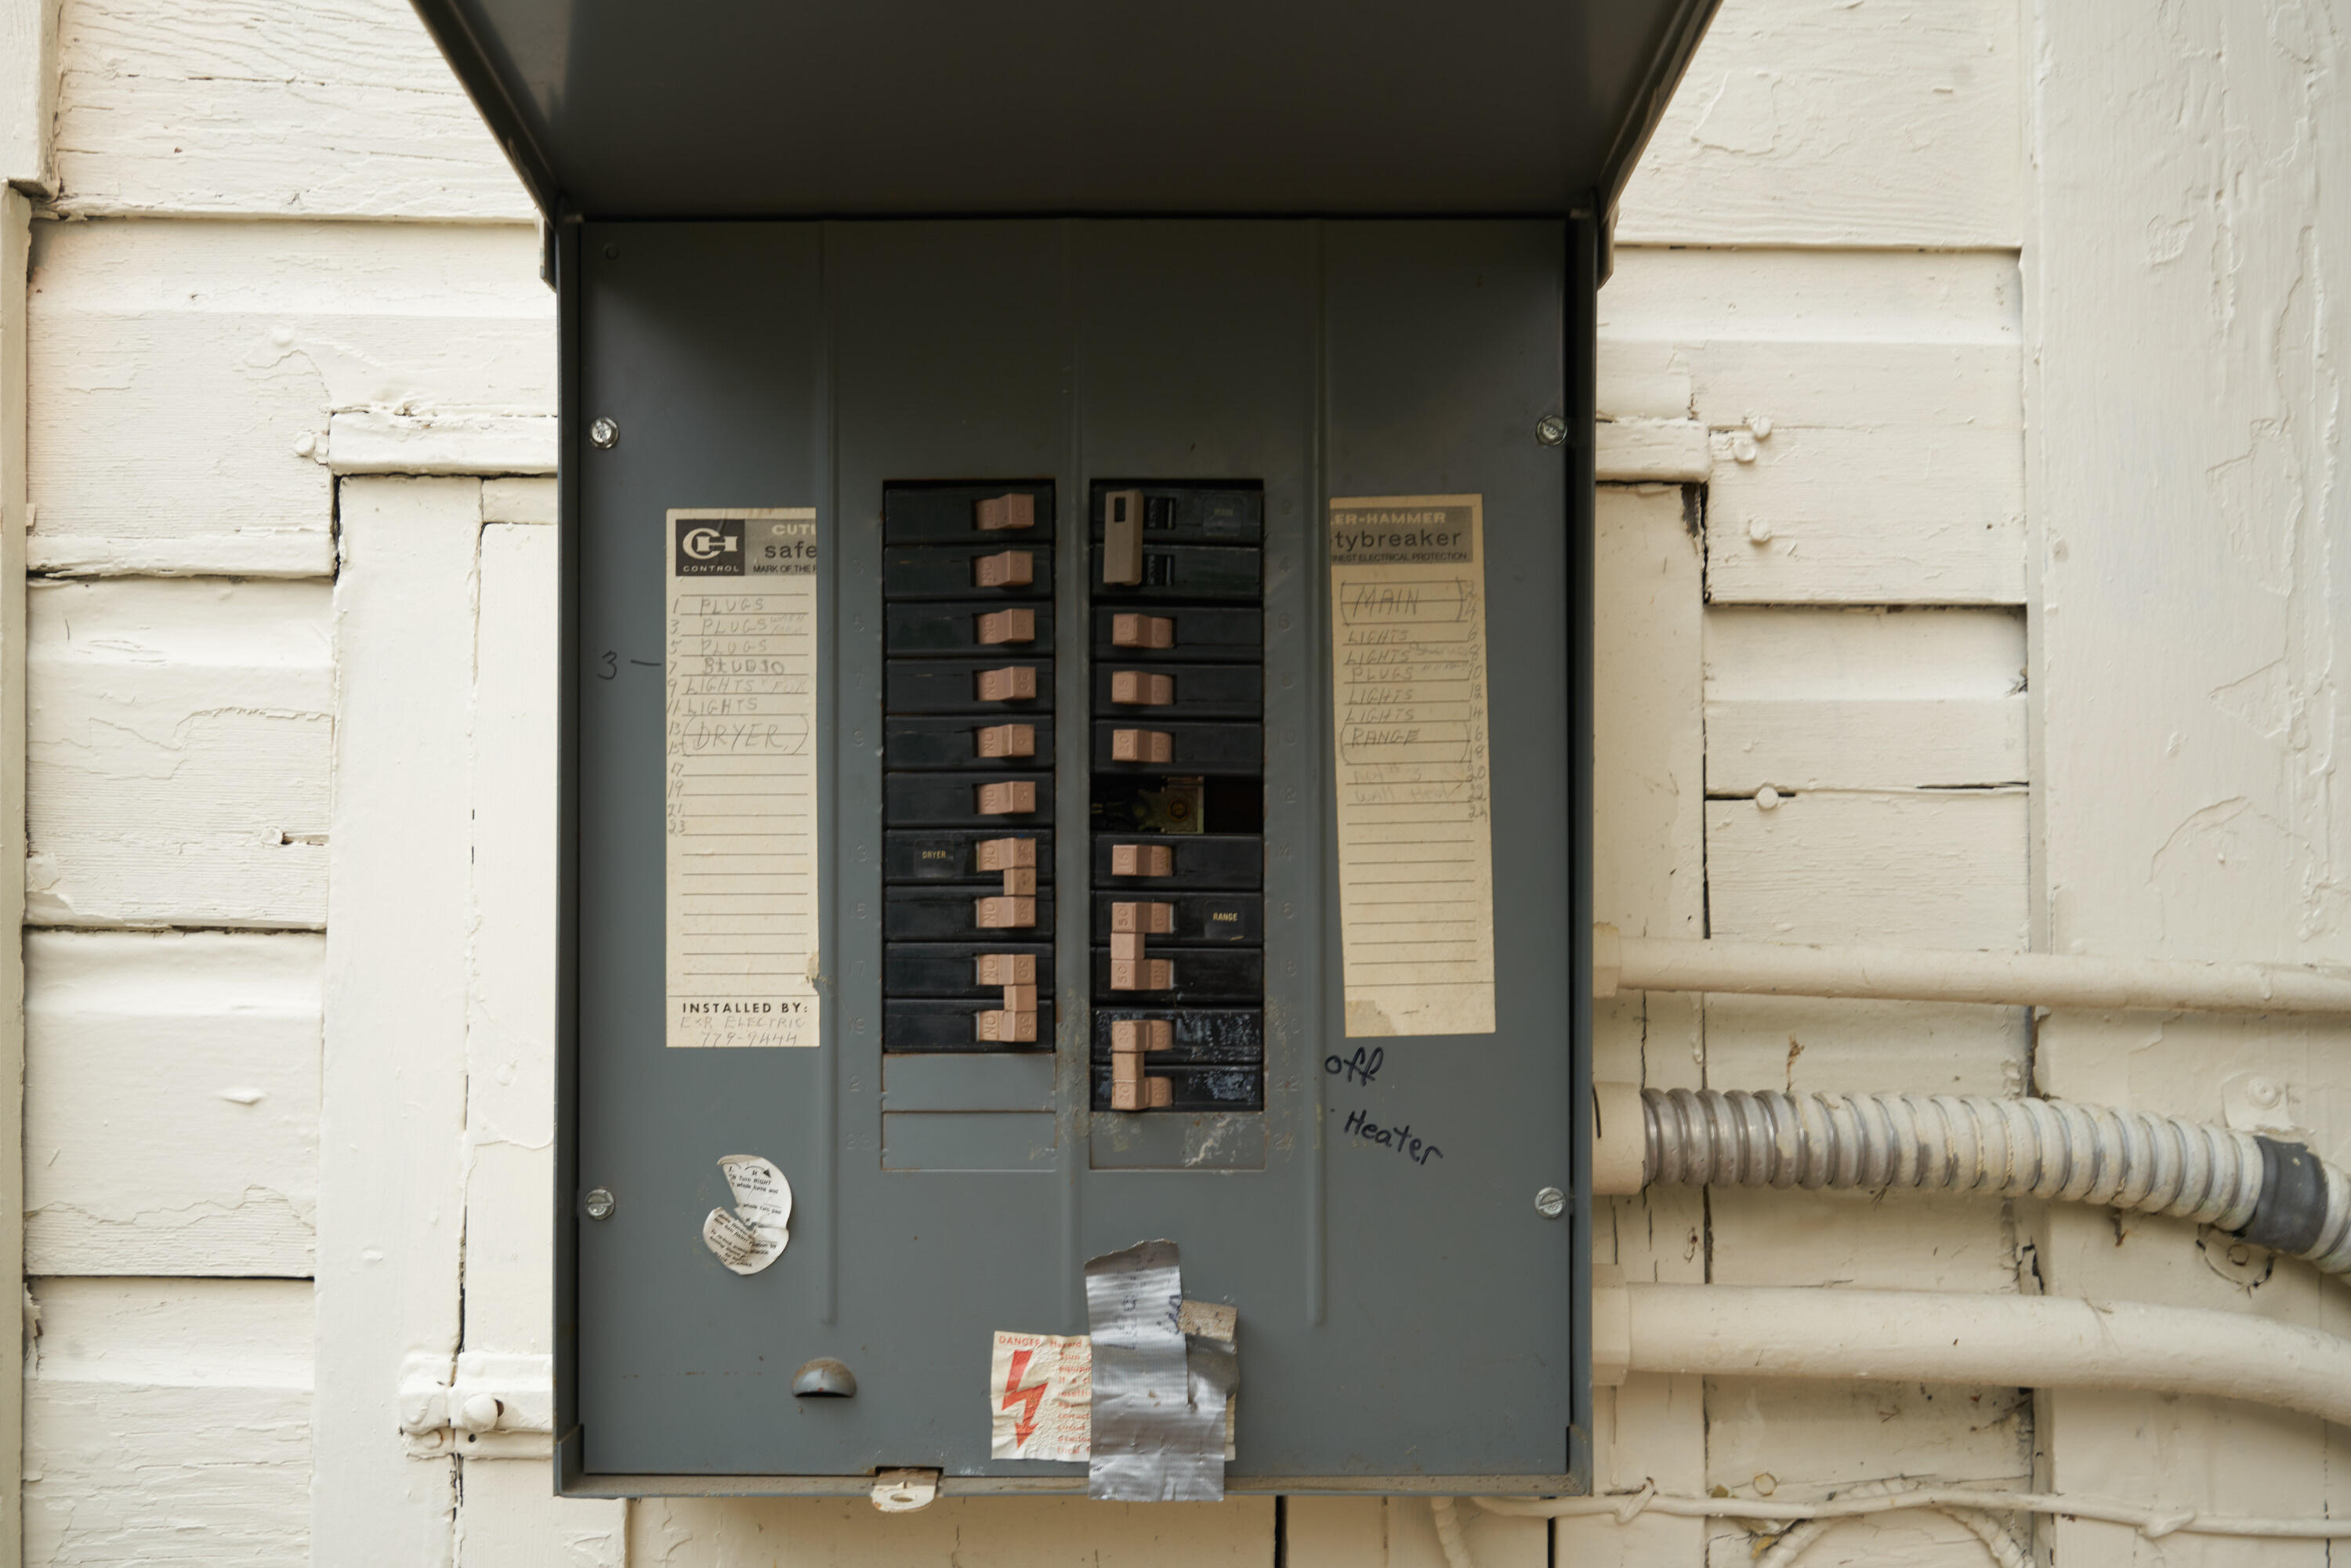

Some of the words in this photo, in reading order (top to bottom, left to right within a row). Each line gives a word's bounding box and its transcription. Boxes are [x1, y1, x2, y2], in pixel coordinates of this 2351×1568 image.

[1331, 512, 1447, 525] ER-HAMMER
[1335, 528, 1462, 552] tybreaker
[764, 541, 817, 559] safe
[1358, 552, 1409, 562] ELECTRICAL
[1411, 551, 1468, 560] PROTECTION
[683, 564, 740, 574] CONTROL
[753, 565, 778, 574] MARK
[780, 565, 792, 574] OF
[793, 565, 810, 574] THE
[700, 597, 764, 617] PLUGS
[1353, 584, 1419, 618] MAIN
[670, 618, 681, 636] 3
[702, 618, 768, 636] PLUGS
[1347, 629, 1409, 644] LIGHTS
[1466, 621, 1479, 642] 6
[670, 639, 683, 655] 5
[701, 639, 767, 658] PLUGS
[1346, 650, 1411, 665] LIGHTS
[596, 650, 618, 681] 3
[668, 661, 678, 675] 7
[1353, 665, 1414, 682] PLUGS
[1466, 664, 1483, 681] 10
[668, 678, 678, 699] 9
[686, 676, 755, 695] LIGHTS
[984, 677, 996, 697] ON
[1348, 687, 1415, 705] LIGHTS
[687, 697, 759, 715] LIGHTS
[1346, 708, 1415, 722] LIGHTS
[984, 733, 995, 754] ON
[1352, 727, 1421, 748] RANGE
[668, 780, 683, 798] 19
[984, 790, 997, 809] ON
[668, 802, 682, 818] 21
[668, 818, 686, 837] 23
[984, 844, 997, 866] ON
[984, 903, 996, 922] ON
[1212, 912, 1238, 922] RANGE
[984, 960, 998, 980] ON
[1154, 965, 1166, 985] ON
[683, 1002, 772, 1013] INSTALLED
[781, 1002, 809, 1013] BY:
[724, 1016, 806, 1028] ELECTRIC
[984, 1016, 998, 1036] ON
[1154, 1026, 1168, 1045] ON
[1343, 1109, 1444, 1166] Heater
[753, 1177, 772, 1186] RIGHT
[998, 1334, 1041, 1346] DANGER
